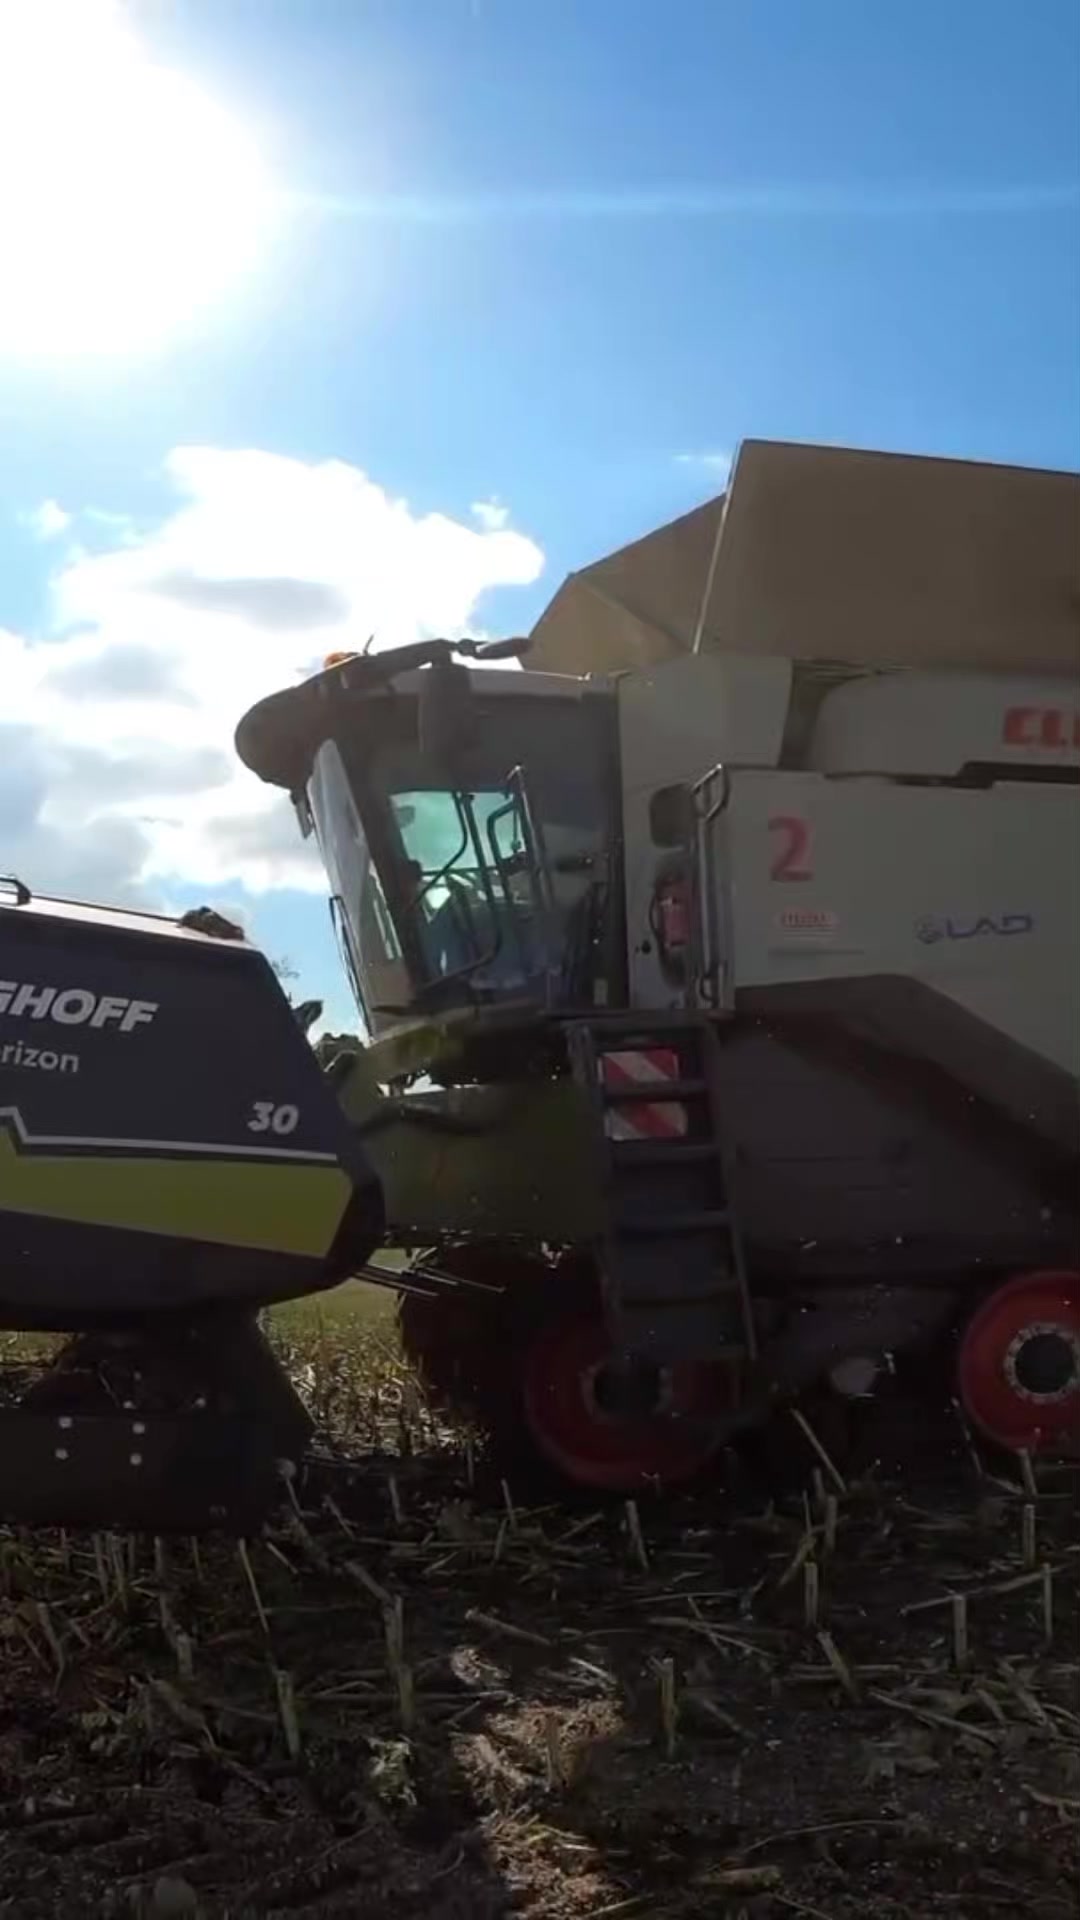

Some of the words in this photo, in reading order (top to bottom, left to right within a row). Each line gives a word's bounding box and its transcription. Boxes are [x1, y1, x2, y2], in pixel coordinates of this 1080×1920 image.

[1002, 706, 1080, 744] CL
[768, 816, 815, 882] 2
[1, 1040, 80, 1072] rizon
[247, 1101, 300, 1135] 30
